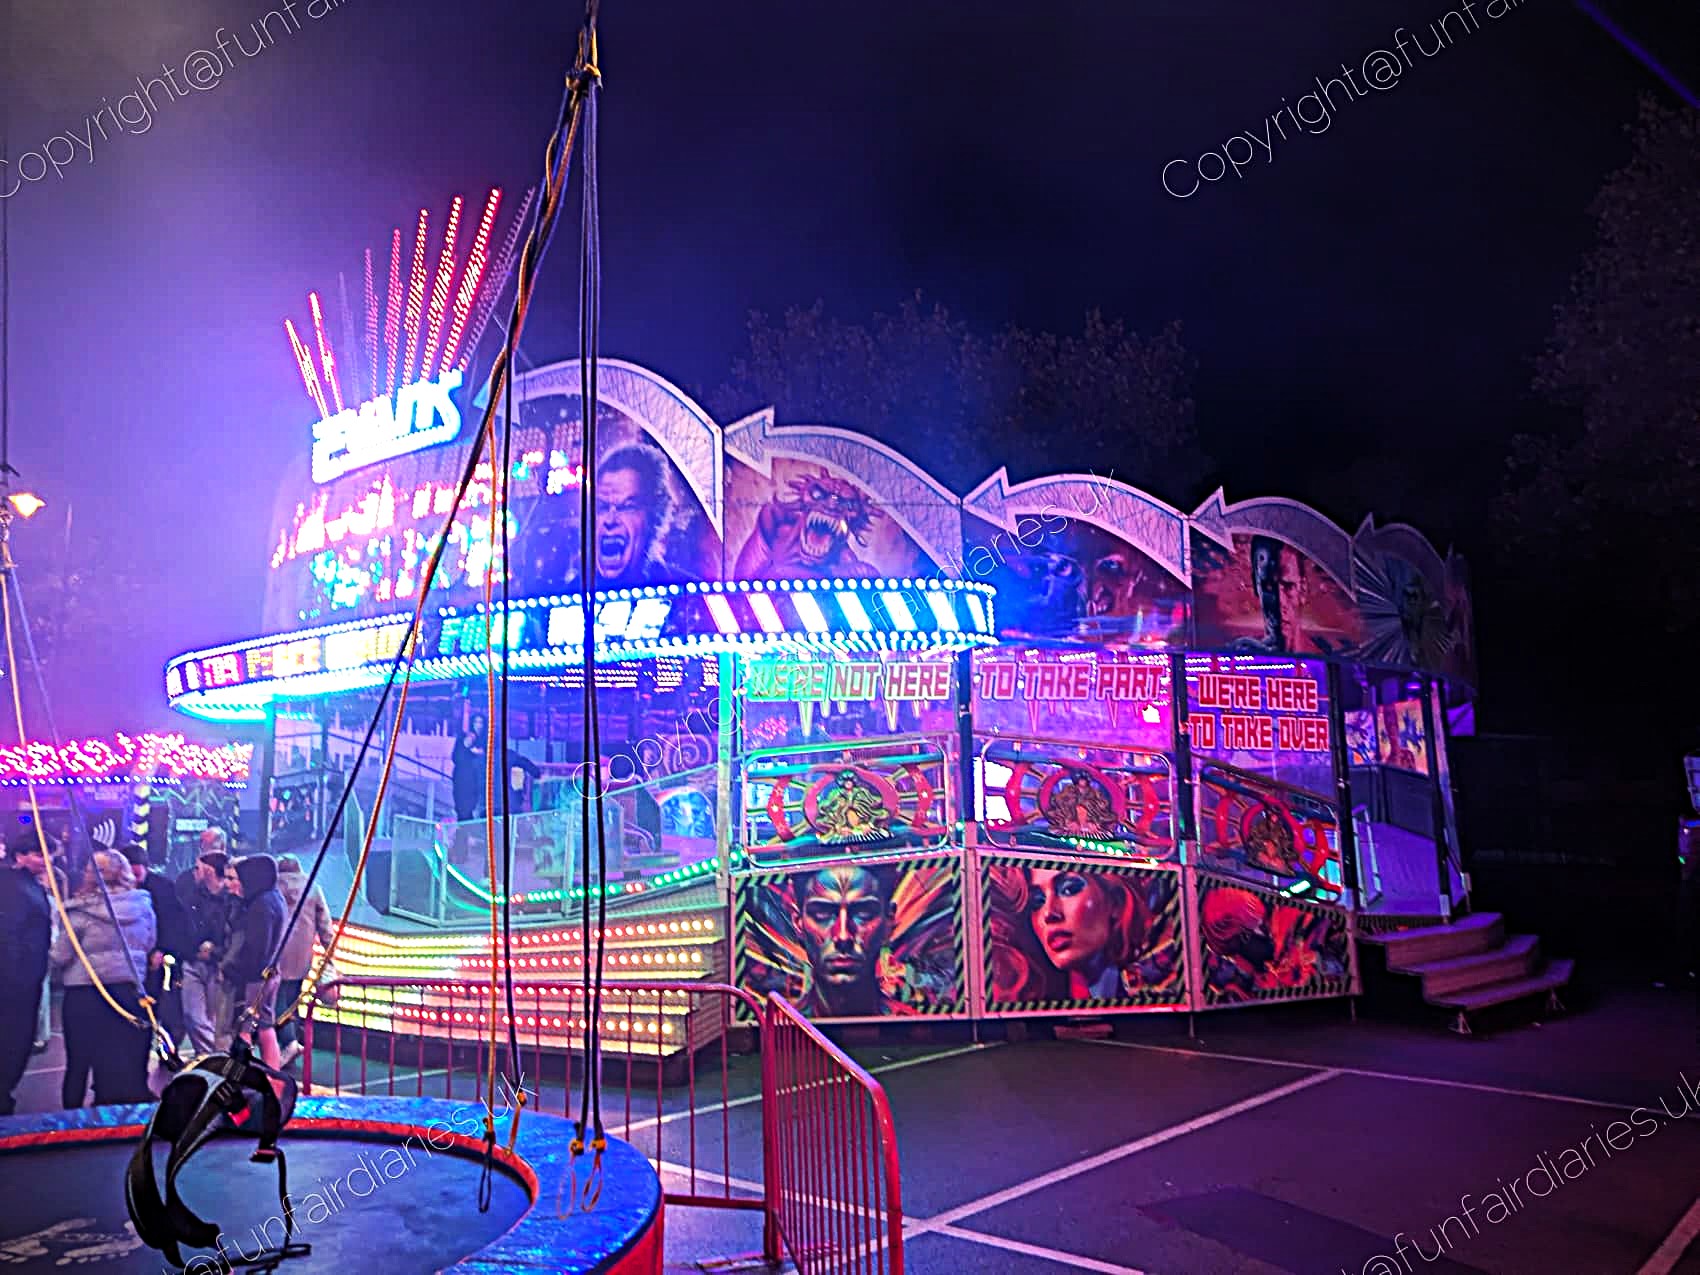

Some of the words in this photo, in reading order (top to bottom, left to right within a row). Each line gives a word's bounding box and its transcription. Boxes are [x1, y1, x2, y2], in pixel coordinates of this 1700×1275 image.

[830, 662, 882, 701] NOT
[884, 661, 951, 700] HERE
[979, 663, 1016, 700] TO
[1022, 663, 1091, 700] TAKE
[1095, 664, 1164, 701] PART
[1265, 677, 1319, 712] HERE
[1188, 713, 1215, 749] TO
[1221, 714, 1273, 750] TAKE
[1277, 716, 1330, 752] OVER
